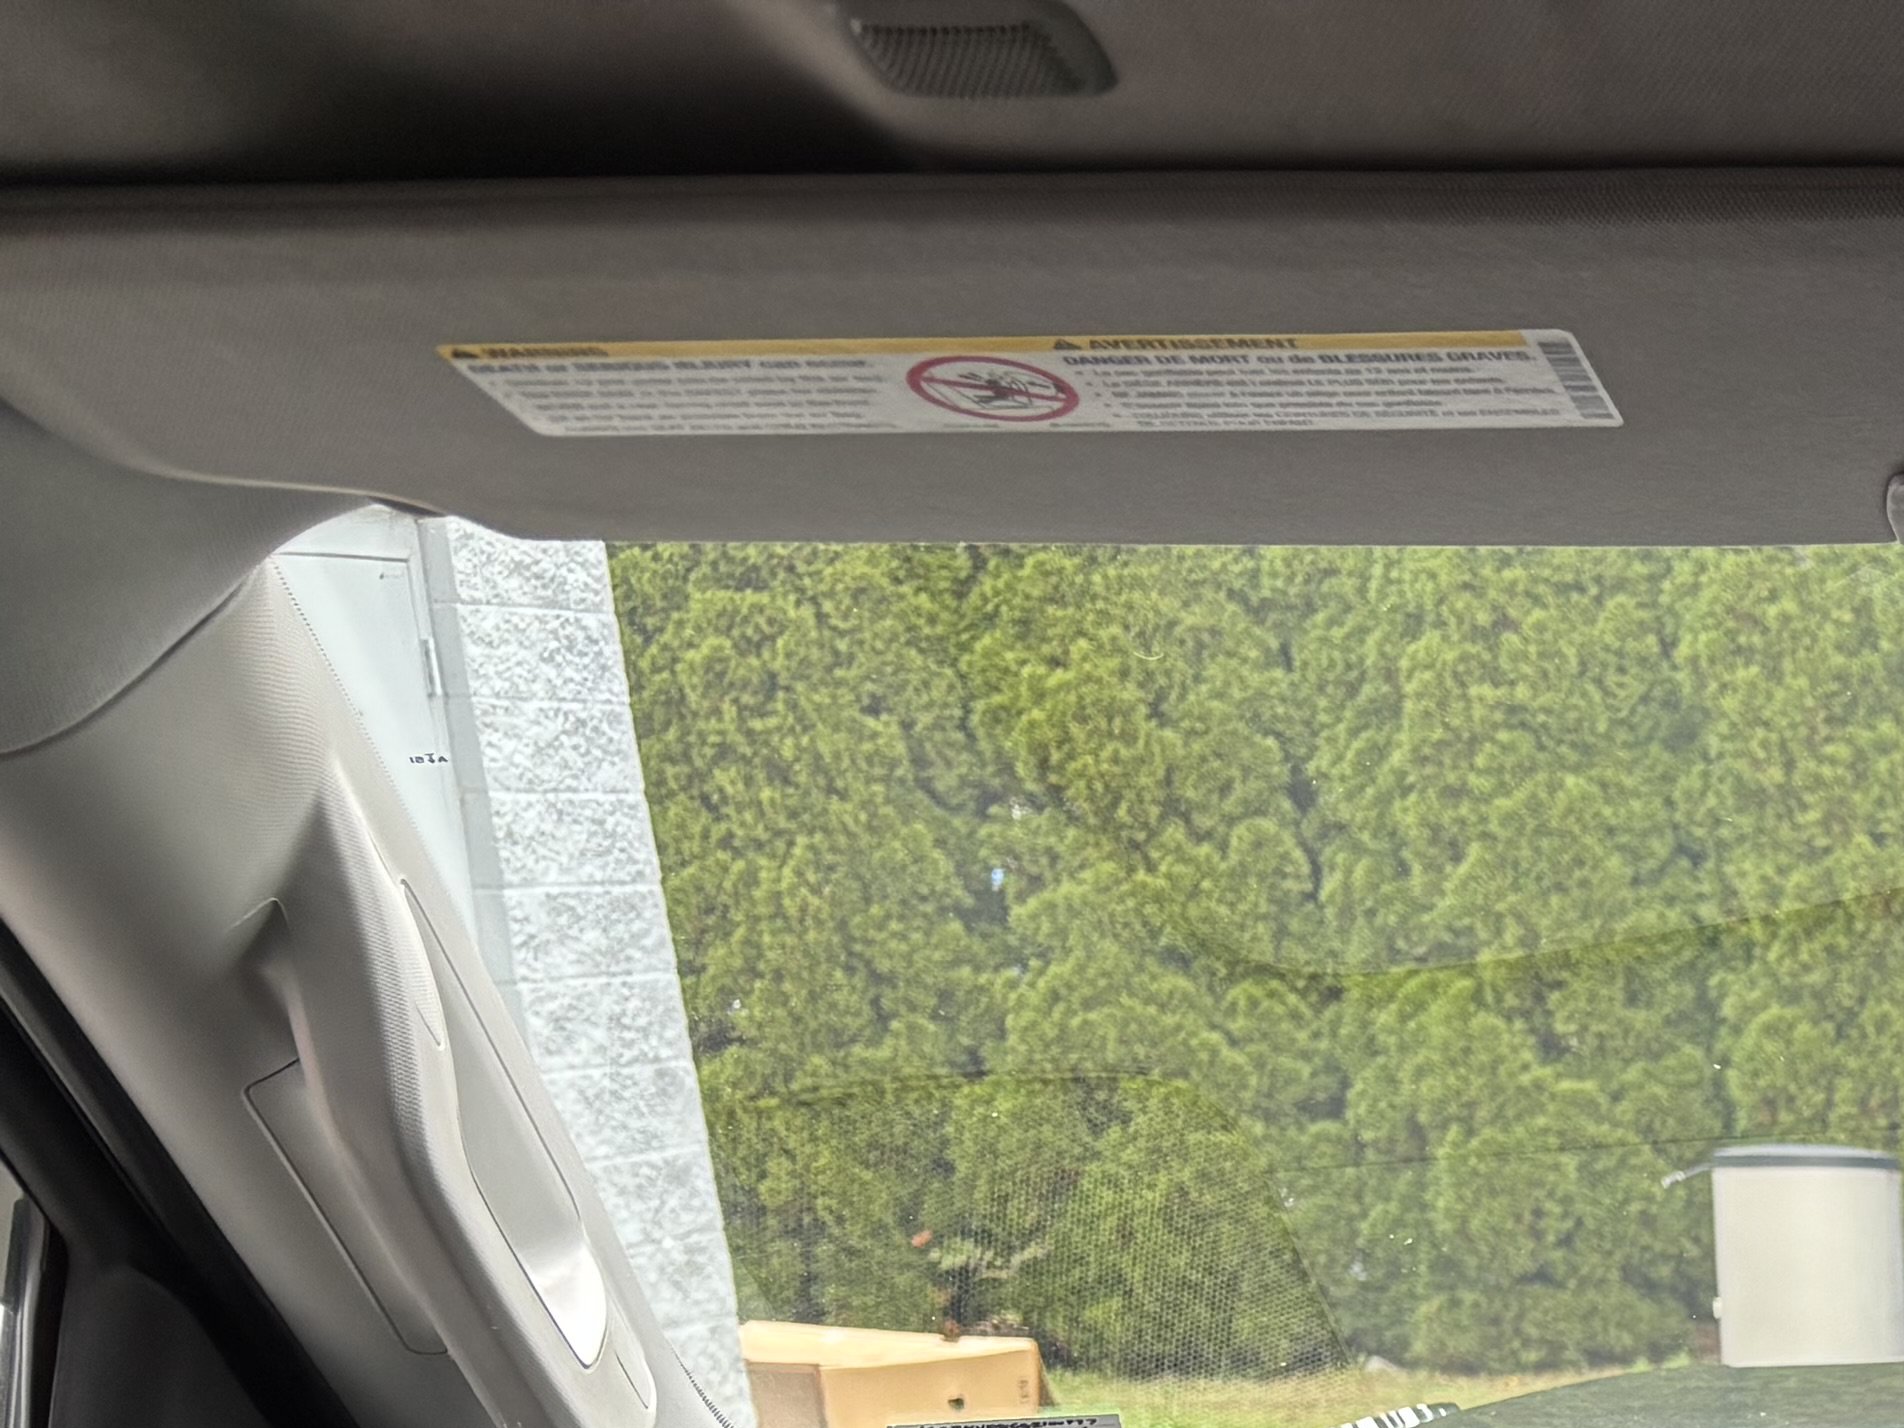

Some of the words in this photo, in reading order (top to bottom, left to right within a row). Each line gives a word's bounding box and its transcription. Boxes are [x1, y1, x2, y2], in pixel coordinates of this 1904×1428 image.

[1088, 338, 1298, 351] AVERTISSEMENT
[1062, 355, 1152, 365] DANGER
[1188, 353, 1250, 365] MORT
